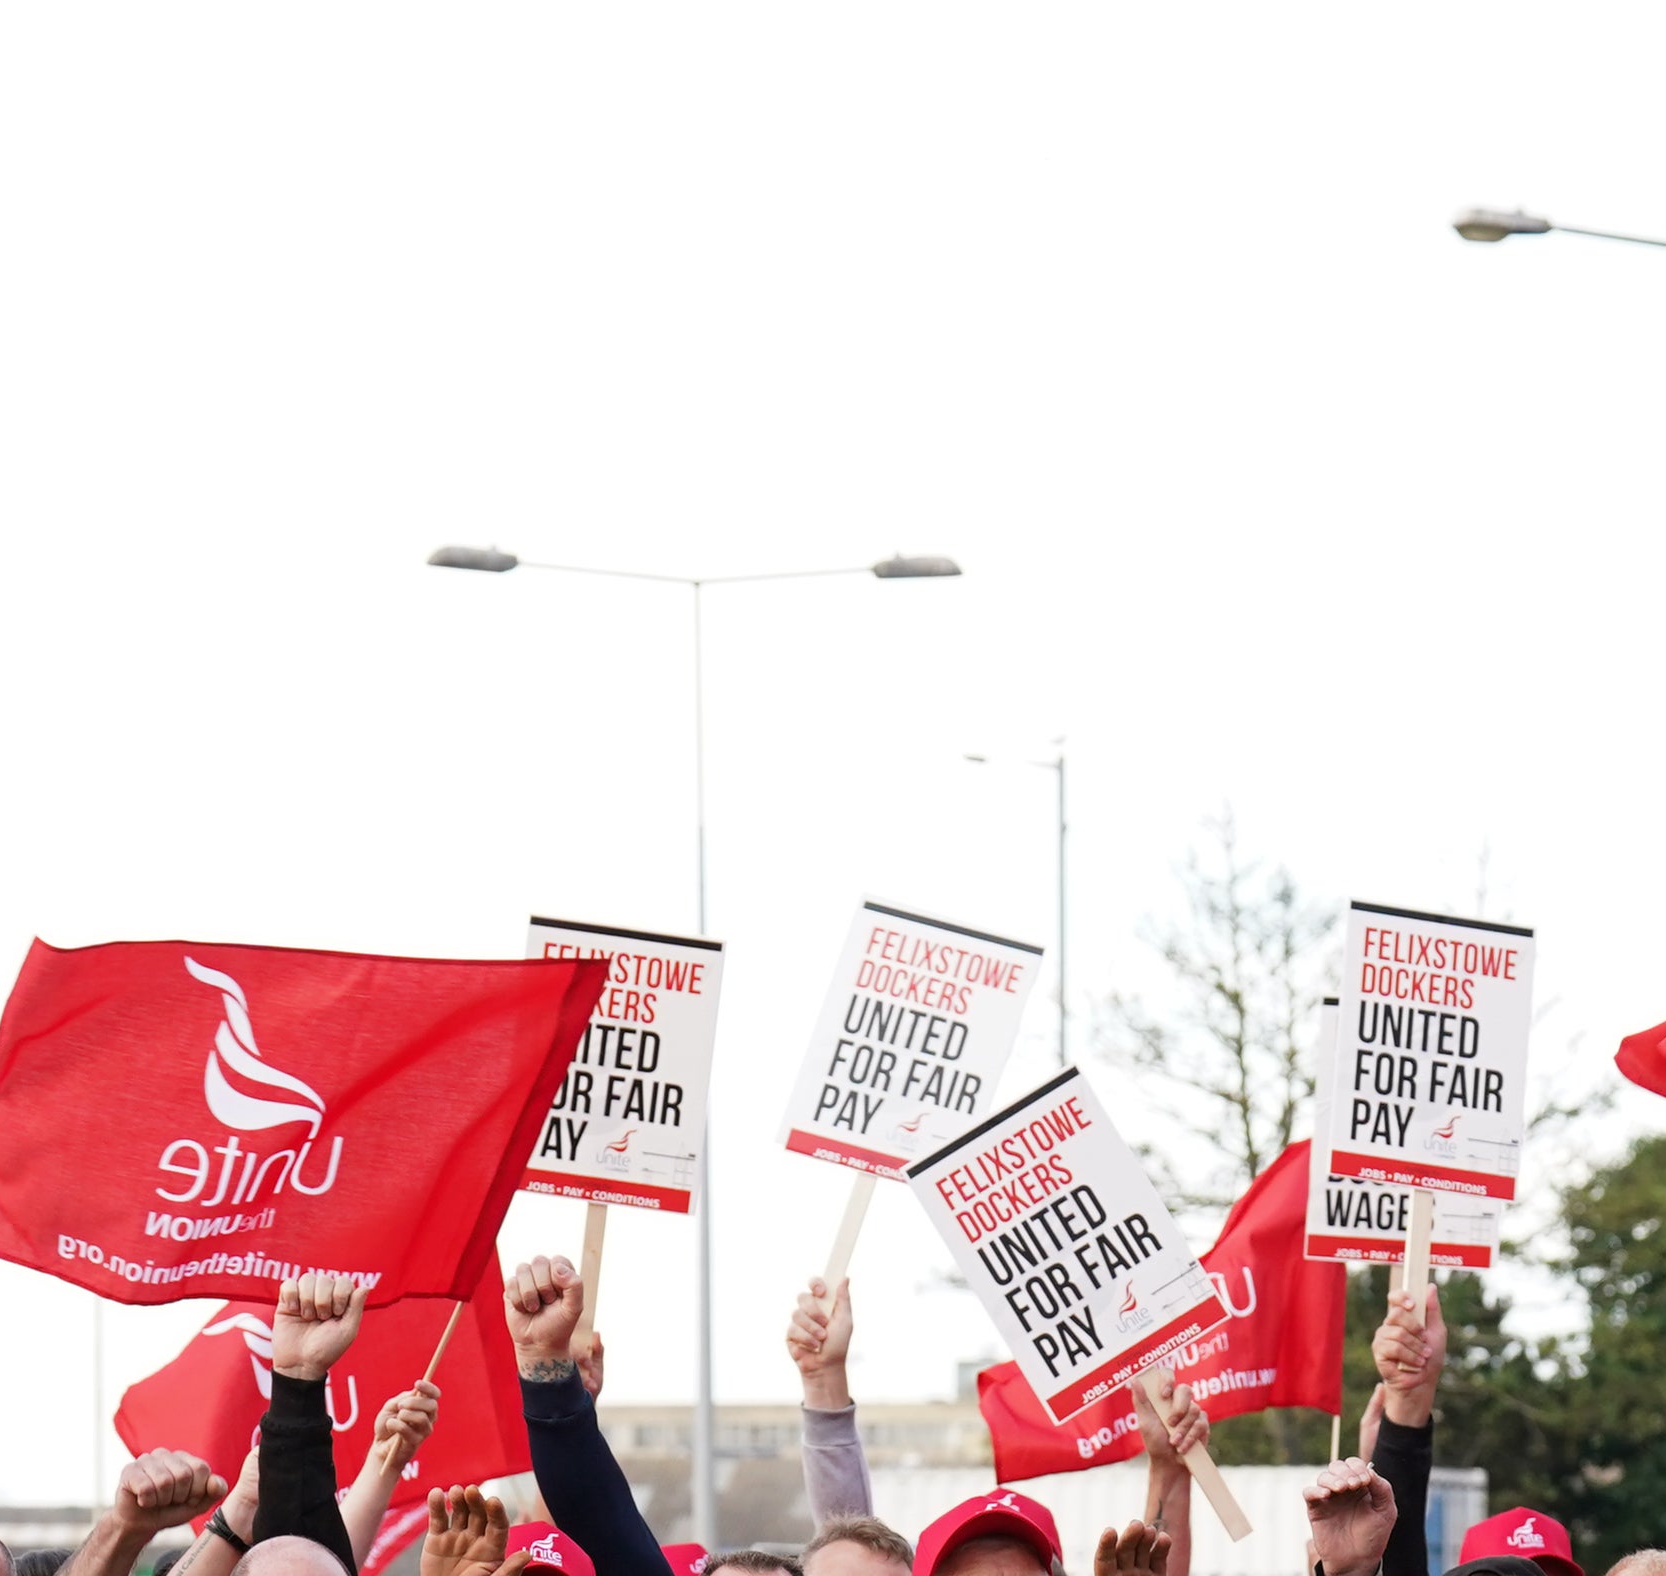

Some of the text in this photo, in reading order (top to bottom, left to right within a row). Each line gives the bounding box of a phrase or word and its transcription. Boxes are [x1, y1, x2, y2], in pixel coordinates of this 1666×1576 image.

[866, 926, 1024, 994] FELIXSTOWE
[1363, 926, 1518, 981] FELIXSTOWE
[856, 959, 973, 1015] DOCKERS
[1360, 963, 1475, 1009] DOCKERS
[843, 994, 969, 1061] UNITED
[1358, 1000, 1480, 1059] UNITED
[604, 1074, 684, 1127] FAIR
[827, 1038, 982, 1115] FOR FAIR
[1354, 1049, 1503, 1113] FOR FAIR
[813, 1083, 885, 1134] PAY
[1350, 1098, 1415, 1148] PAY
[540, 1116, 587, 1162] AY
[935, 1096, 1093, 1211] FELIXSTOWE
[526, 1181, 660, 1209] JOBS PAY CONDITIONS
[956, 1154, 1073, 1243] DOCKERS
[1358, 1167, 1386, 1180] JOBS
[1393, 1172, 1414, 1184] PAY
[1421, 1176, 1487, 1195] CONDITIONS
[977, 1184, 1107, 1286] UNITED
[1326, 1188, 1435, 1232] WAGE
[1004, 1213, 1163, 1333] FOR FAIR
[1335, 1248, 1362, 1259] JOBS
[1369, 1250, 1390, 1261] PAY
[1032, 1305, 1104, 1378] PAY
[1082, 1381, 1109, 1404] JOBS
[1112, 1364, 1133, 1384] PAY
[1138, 1323, 1202, 1367] CONDITIONS
